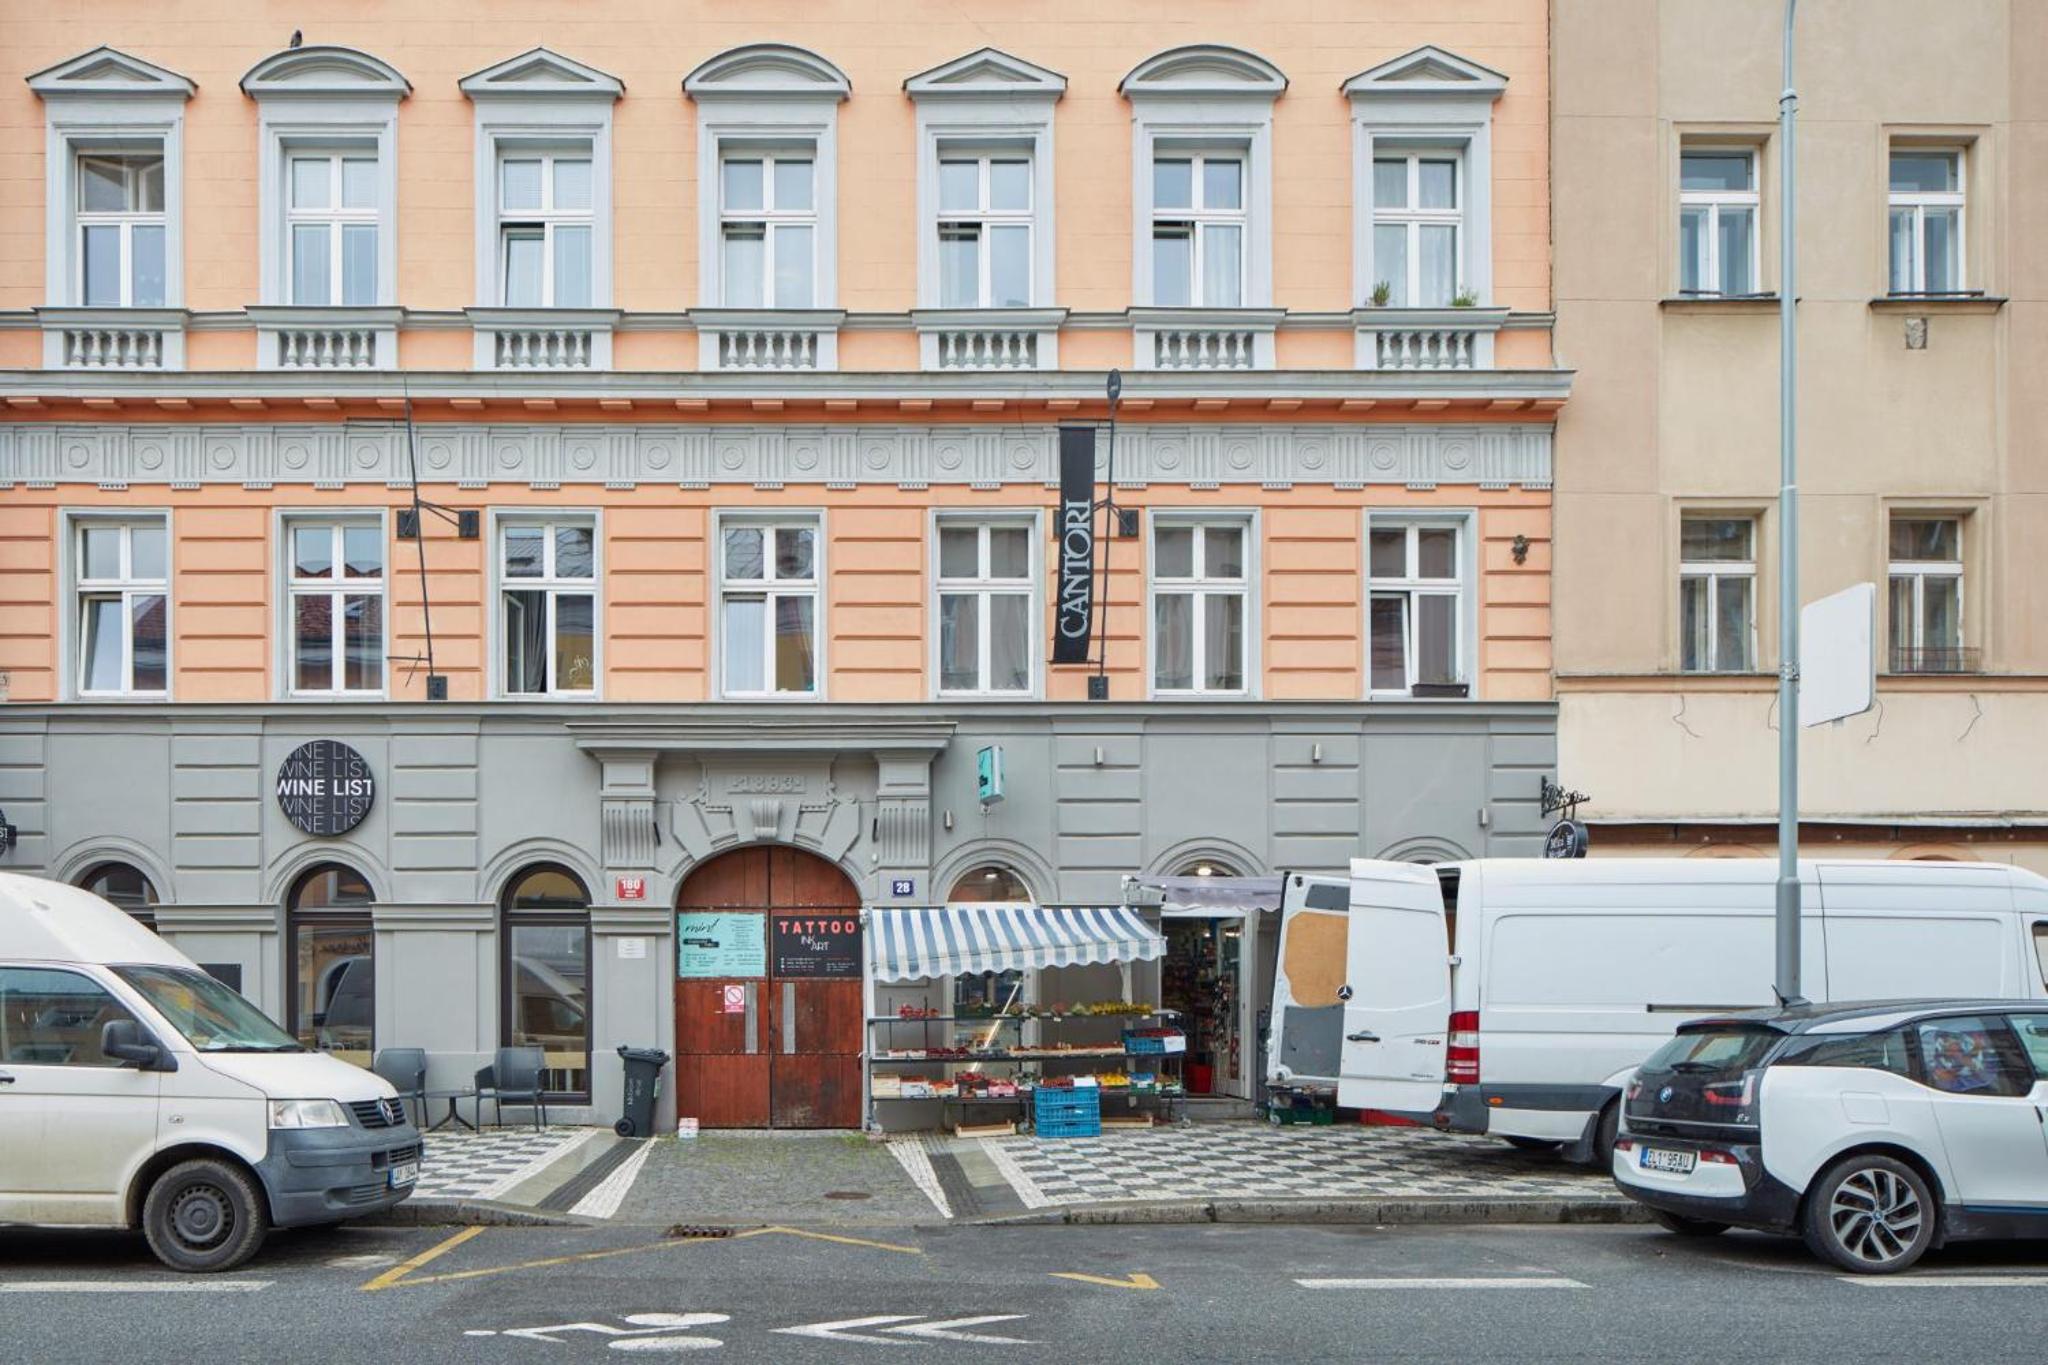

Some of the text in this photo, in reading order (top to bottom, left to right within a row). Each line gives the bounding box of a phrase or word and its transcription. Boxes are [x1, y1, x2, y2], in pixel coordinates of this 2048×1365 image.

[1060, 498, 1092, 639] CANTORI
[277, 779, 372, 796] WINE LIST
[332, 797, 371, 814] LIST
[896, 882, 910, 894] 28
[779, 921, 855, 935] TATTOO
[810, 941, 829, 951] ART
